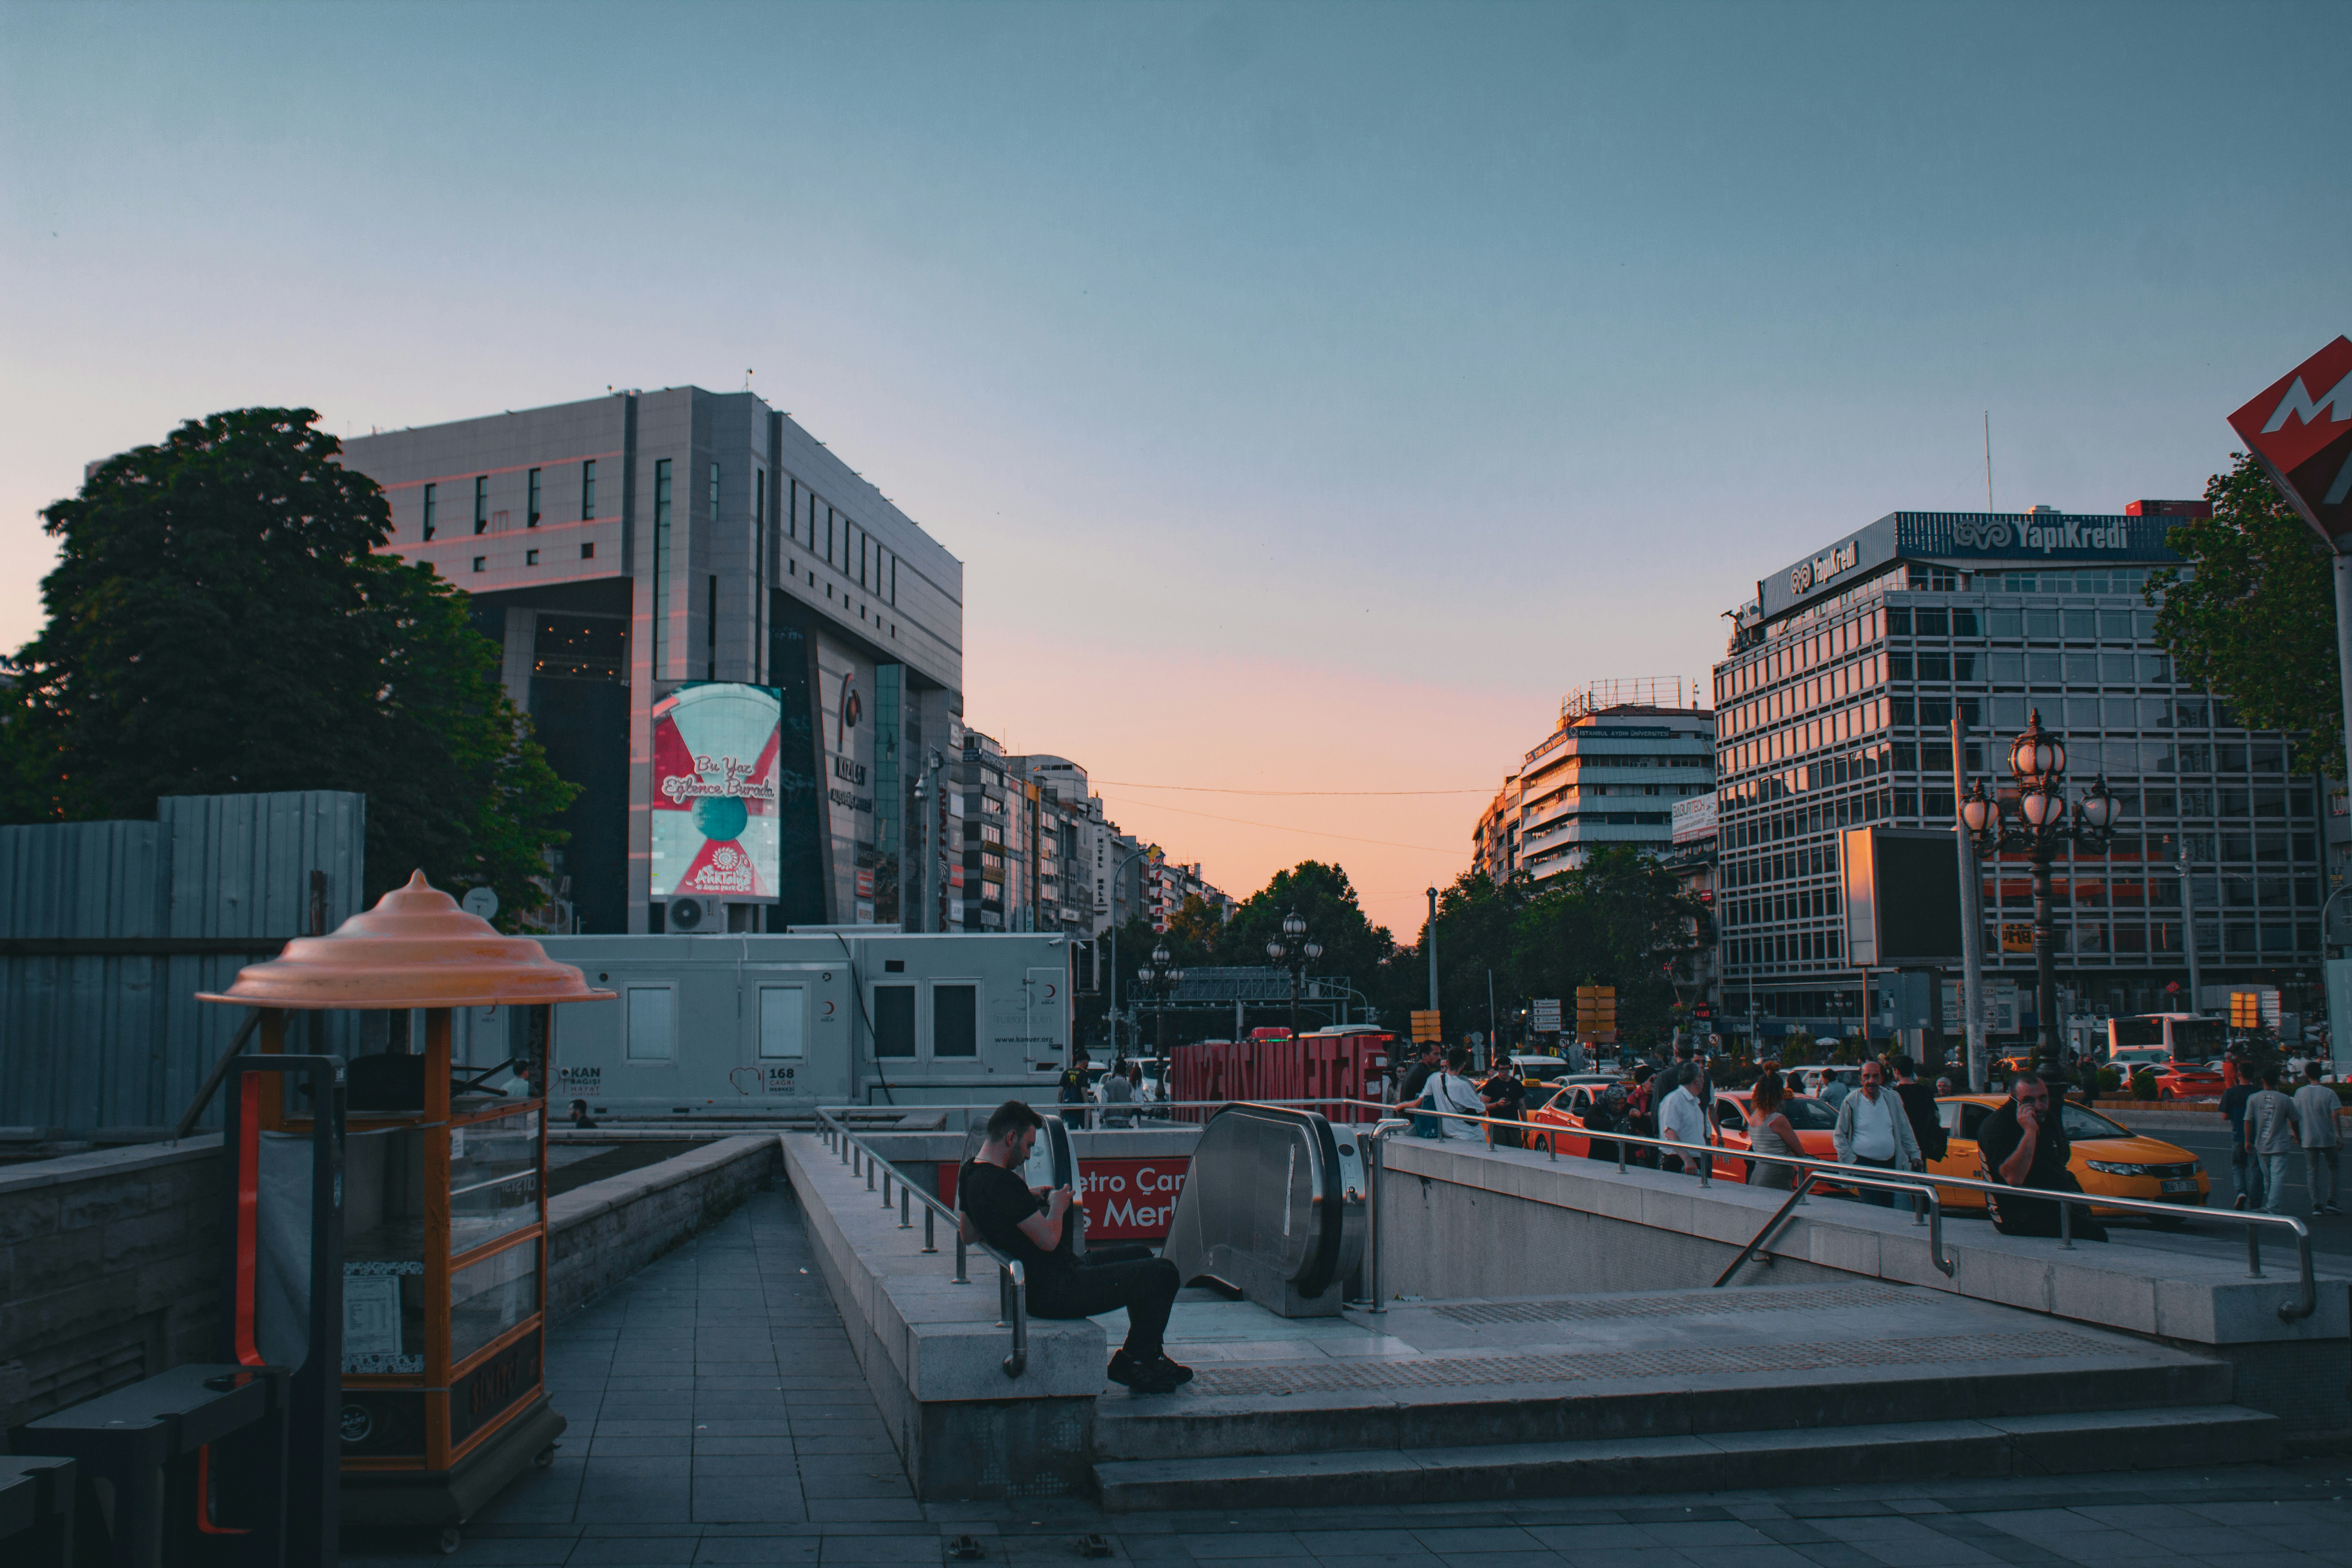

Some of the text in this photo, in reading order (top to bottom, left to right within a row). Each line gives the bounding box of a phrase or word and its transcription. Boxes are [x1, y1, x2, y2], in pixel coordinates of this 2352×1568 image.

[2014, 520, 2128, 554] YapıKredi
[1812, 540, 1857, 584] YapıKredi
[695, 755, 752, 778] Bu Yaz
[836, 756, 866, 786] KIZILAY
[665, 777, 774, 801] Eğlence Burada
[571, 1067, 600, 1078] KAN
[571, 1077, 600, 1086] BAĞIŞI
[769, 1068, 794, 1078] 168
[1079, 1167, 1185, 1195] etro Çar
